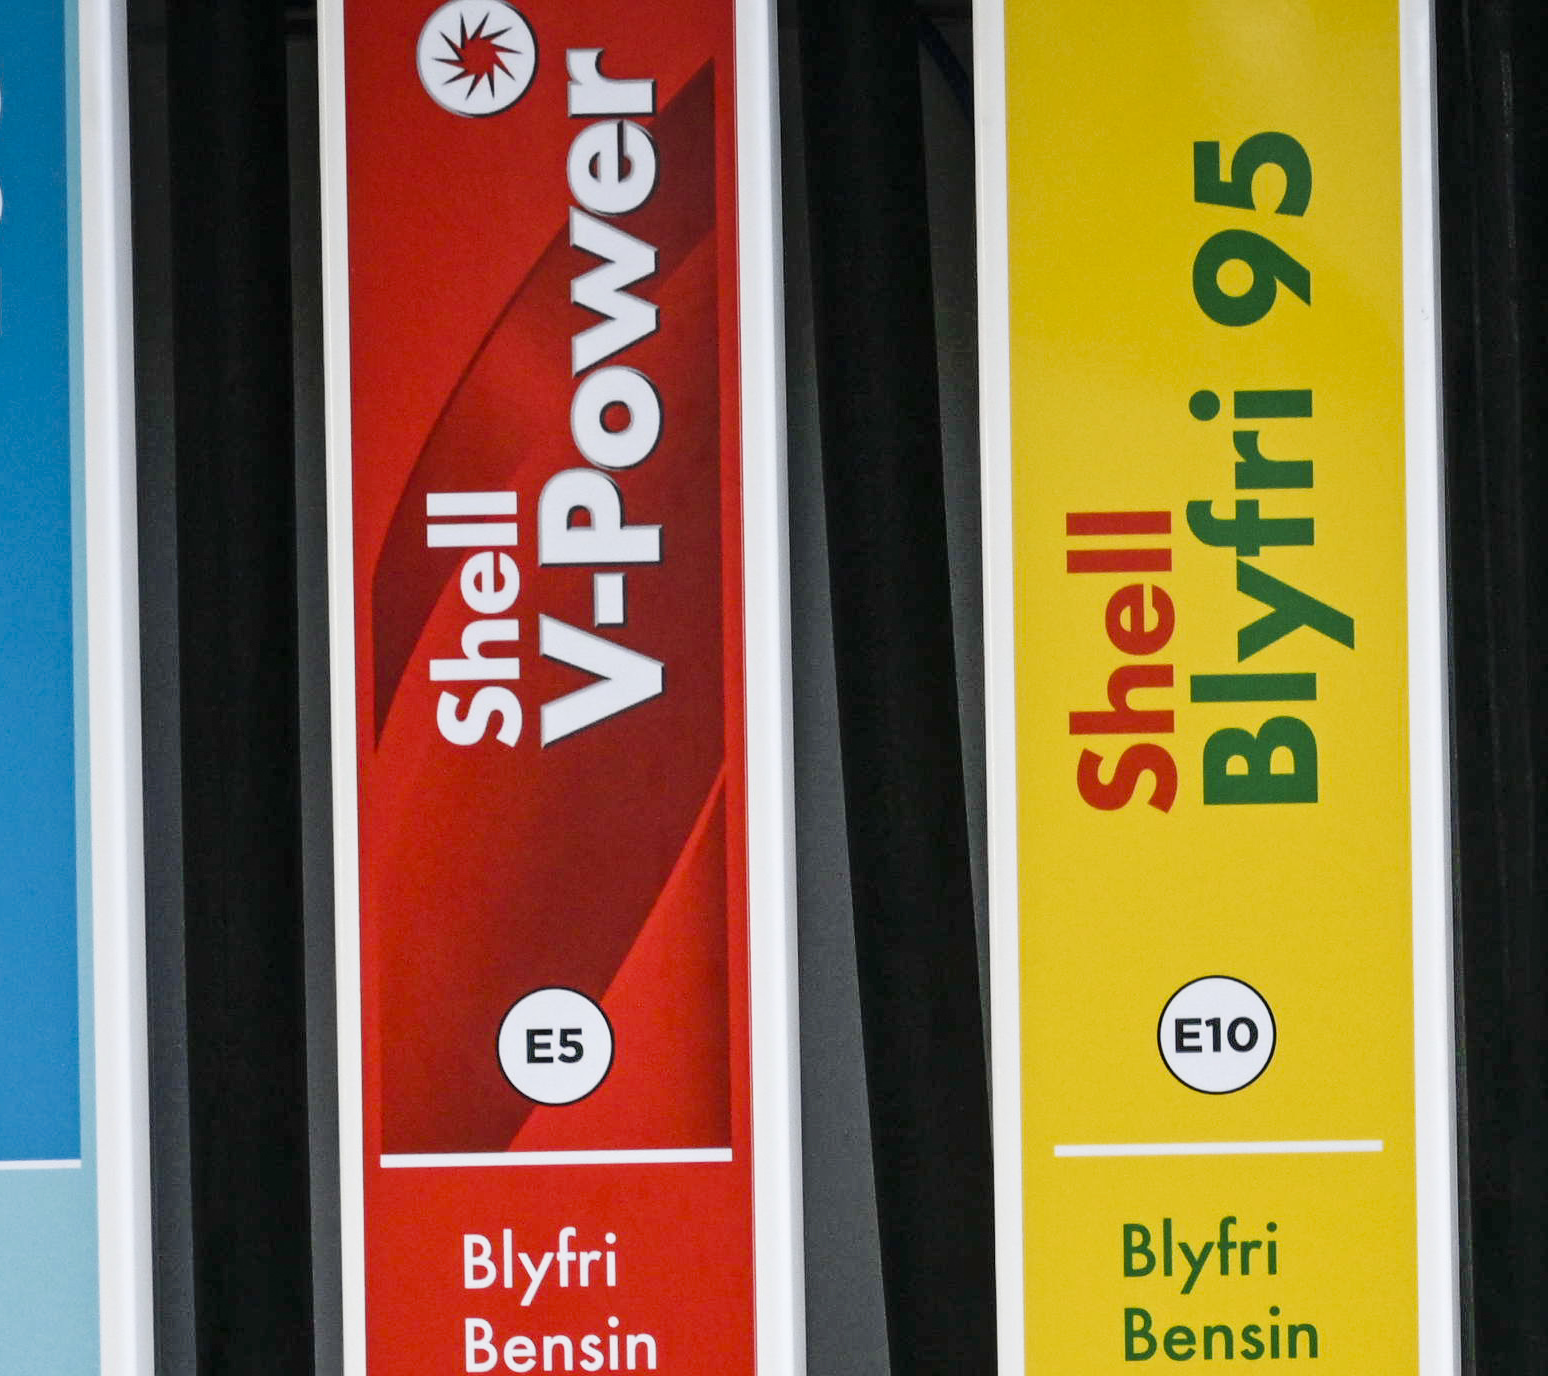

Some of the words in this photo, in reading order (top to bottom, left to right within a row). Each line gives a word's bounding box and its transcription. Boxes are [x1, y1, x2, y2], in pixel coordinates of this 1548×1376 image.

[1191, 130, 1313, 328] 95
[538, 49, 664, 747] V-Power
[427, 491, 522, 747] Shell
[1185, 388, 1355, 806] Blyfri
[1066, 511, 1178, 813] Shell
[526, 1028, 583, 1064] E5
[1175, 1017, 1258, 1053] E10
[464, 1228, 616, 1306] Blyfri
[1123, 1216, 1277, 1294] Blyfri
[465, 1316, 656, 1373] Bensin
[1124, 1306, 1318, 1361] Bensin
